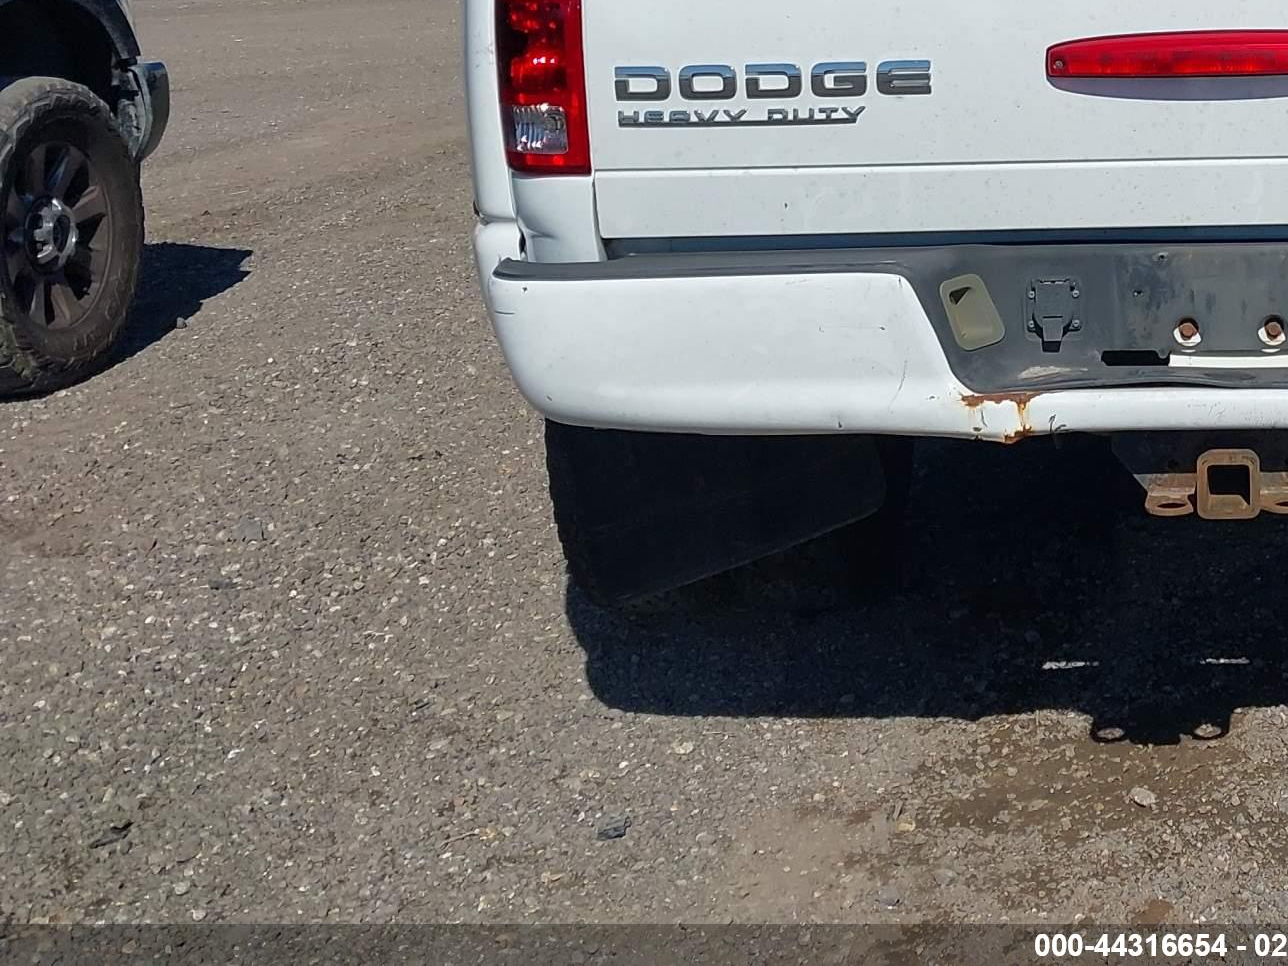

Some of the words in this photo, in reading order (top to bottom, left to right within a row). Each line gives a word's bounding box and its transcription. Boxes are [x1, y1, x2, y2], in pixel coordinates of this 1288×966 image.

[613, 59, 933, 102] DODGE
[617, 107, 749, 125] HEAVY
[766, 105, 867, 124] DUTY
